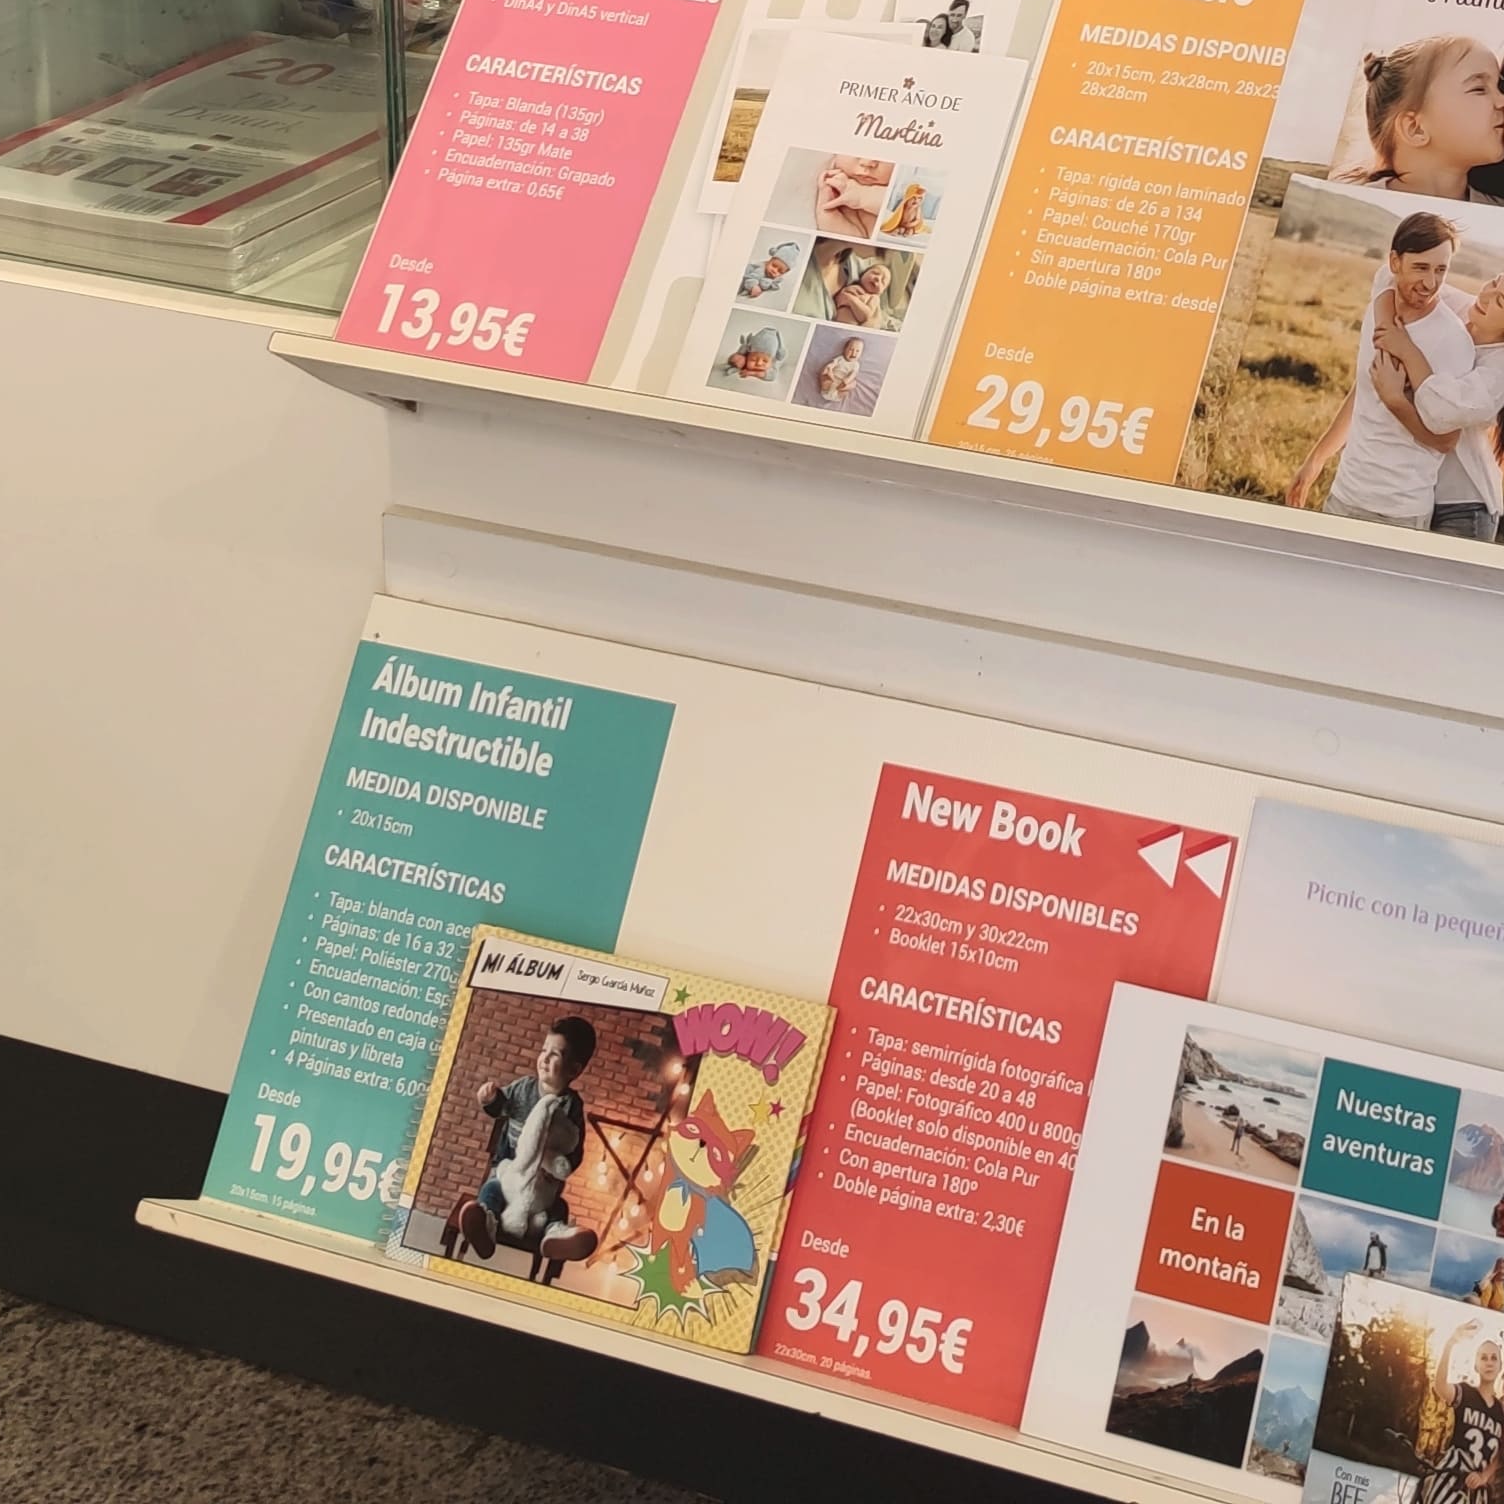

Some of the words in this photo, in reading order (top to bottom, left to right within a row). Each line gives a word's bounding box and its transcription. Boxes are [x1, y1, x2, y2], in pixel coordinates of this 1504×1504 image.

[545, 4, 554, 16] y
[557, 1, 597, 18] DinA5
[600, 8, 649, 26] vertical
[465, 54, 642, 95] CARACTERÍSTICAS
[839, 80, 899, 104] PRIMER
[902, 84, 937, 106] AÑO
[941, 94, 962, 112] DE
[468, 91, 503, 108] Tapa:
[506, 97, 552, 117] Blanda
[555, 105, 604, 125] (135gr)
[452, 129, 492, 149] Papel:
[497, 135, 534, 154] 135gr
[538, 144, 572, 160] Mate
[854, 111, 944, 151] Martina
[445, 149, 552, 177] Encuadernación:
[557, 165, 615, 188] Grapado
[390, 252, 434, 275] Desde
[375, 283, 534, 358] 13,95€
[967, 374, 1154, 456] 29,95€
[372, 656, 463, 706] Álbum
[469, 680, 573, 730] Infantil
[360, 707, 555, 777] Indestructible
[901, 781, 983, 830] New
[989, 800, 1086, 856] Book
[1306, 881, 1366, 912] Picnic
[1370, 894, 1408, 921] con
[1412, 900, 1430, 926] la
[482, 952, 503, 977] MI
[506, 958, 564, 983] ÁLBUM
[669, 1003, 806, 1082] WOW!
[1336, 1089, 1437, 1134] Nuestras
[248, 1114, 400, 1205] 19,95€
[1322, 1131, 1435, 1176] aventuras
[1190, 1206, 1219, 1233] En
[1224, 1214, 1245, 1241] la
[1158, 1244, 1262, 1290] montaña
[785, 1267, 974, 1374] 34,95€
